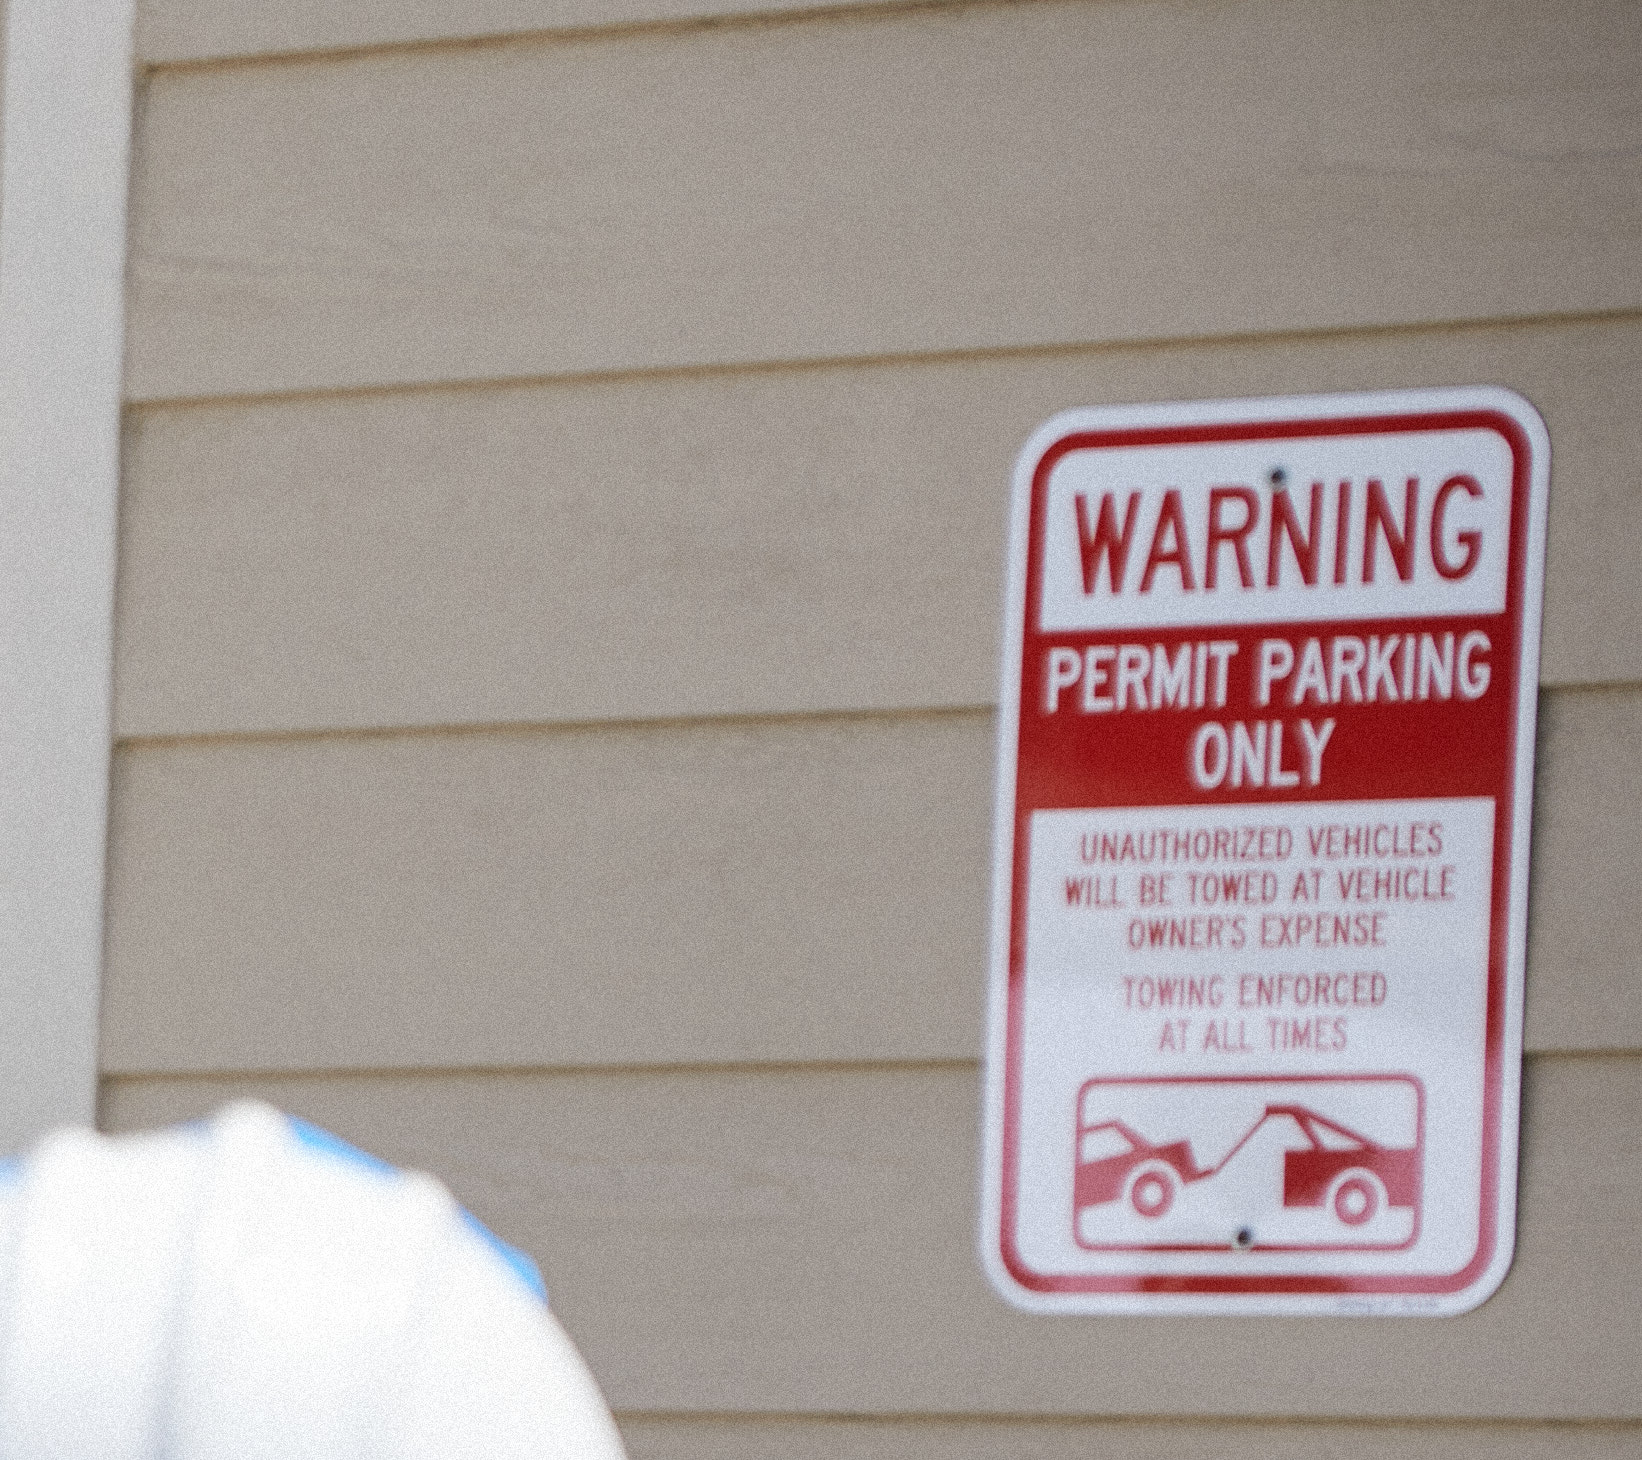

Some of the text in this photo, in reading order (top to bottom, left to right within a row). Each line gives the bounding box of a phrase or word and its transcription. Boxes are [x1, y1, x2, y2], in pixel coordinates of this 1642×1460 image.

[1074, 474, 1484, 596] WARNING
[1046, 629, 1492, 715] PERMIT PARKING
[1192, 718, 1337, 790] ONLY
[1079, 822, 1445, 865] UNAUTHORIZED VEHICLES
[1063, 864, 1456, 910] WILL BE TOWED AT VEHICLE
[1127, 911, 1388, 951] OWNER'S EXPENSE
[1122, 970, 1388, 1010] TOWING ENFORCED
[1158, 1015, 1349, 1054] AT ALL TIMES
